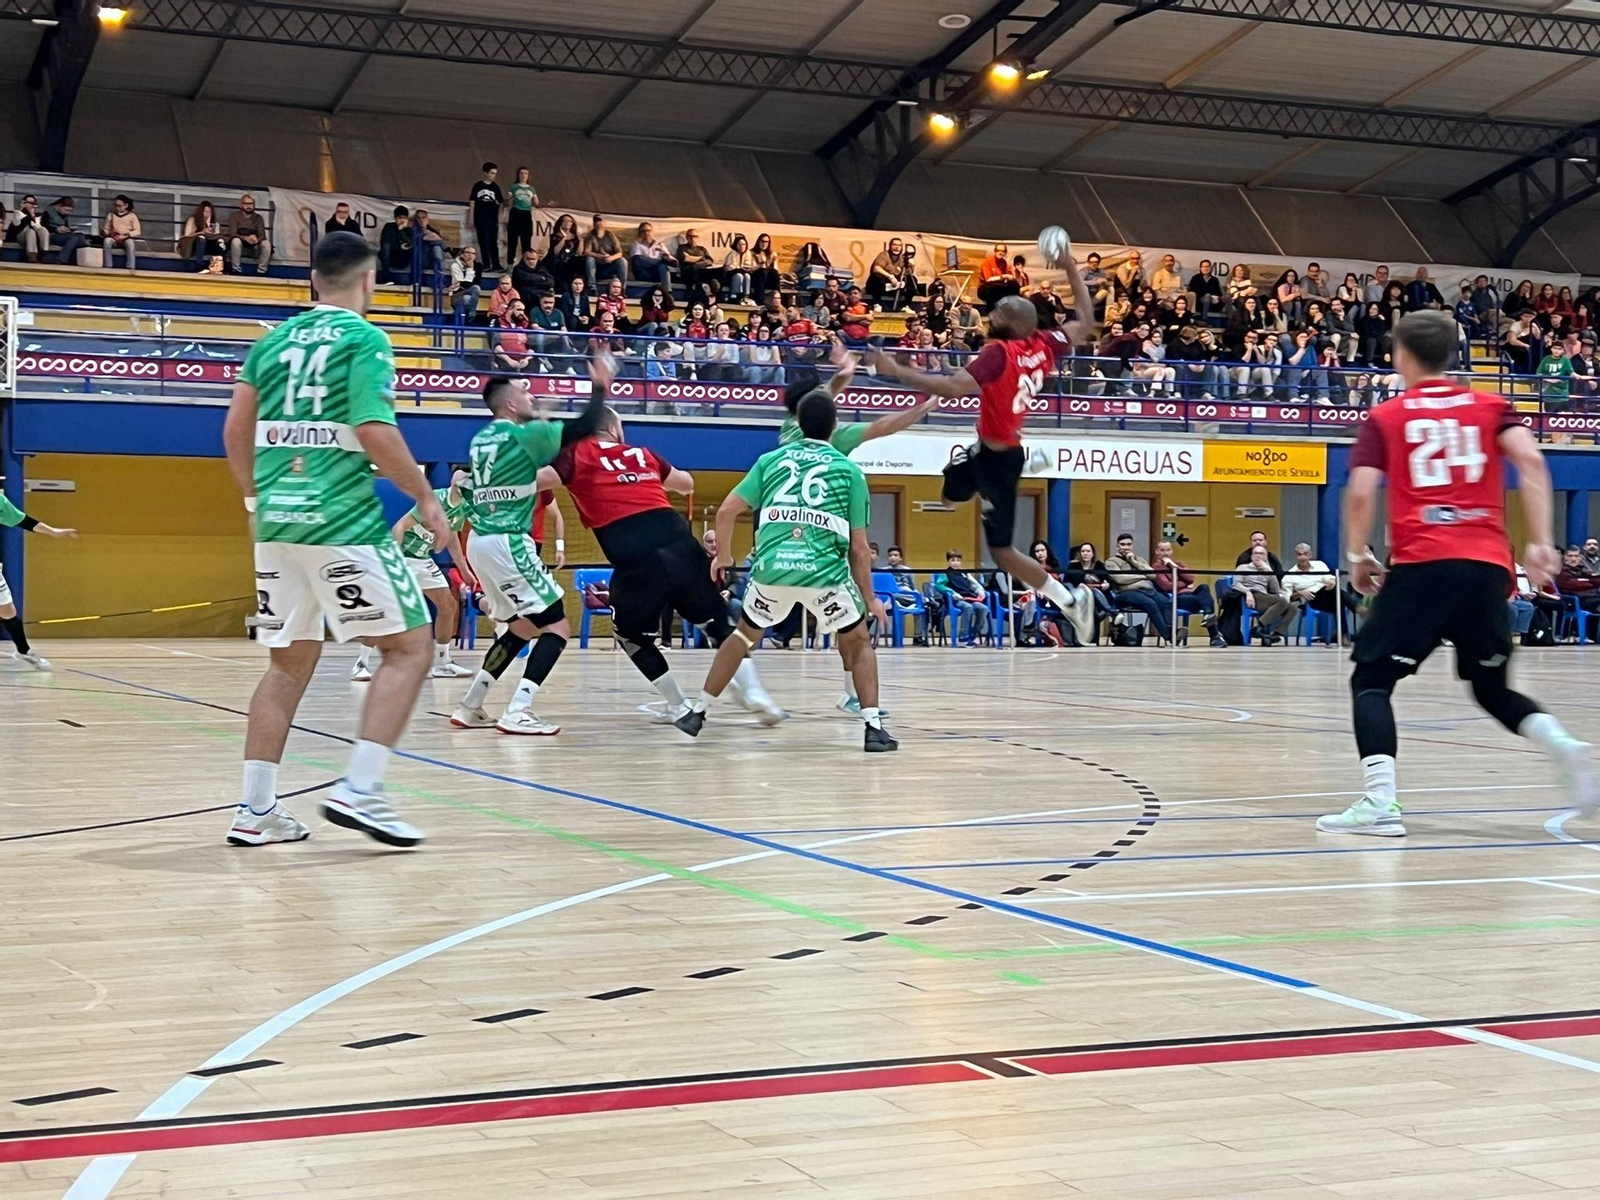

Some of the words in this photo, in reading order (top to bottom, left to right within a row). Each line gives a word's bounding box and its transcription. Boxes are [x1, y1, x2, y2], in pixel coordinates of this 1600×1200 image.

[279, 344, 333, 416] 14
[469, 444, 499, 487] 17
[1057, 447, 1193, 475] PARAGUAS
[1277, 469, 1288, 478] DE
[1404, 418, 1488, 488] 24
[772, 460, 830, 508] 26
[781, 508, 830, 528] valinox
